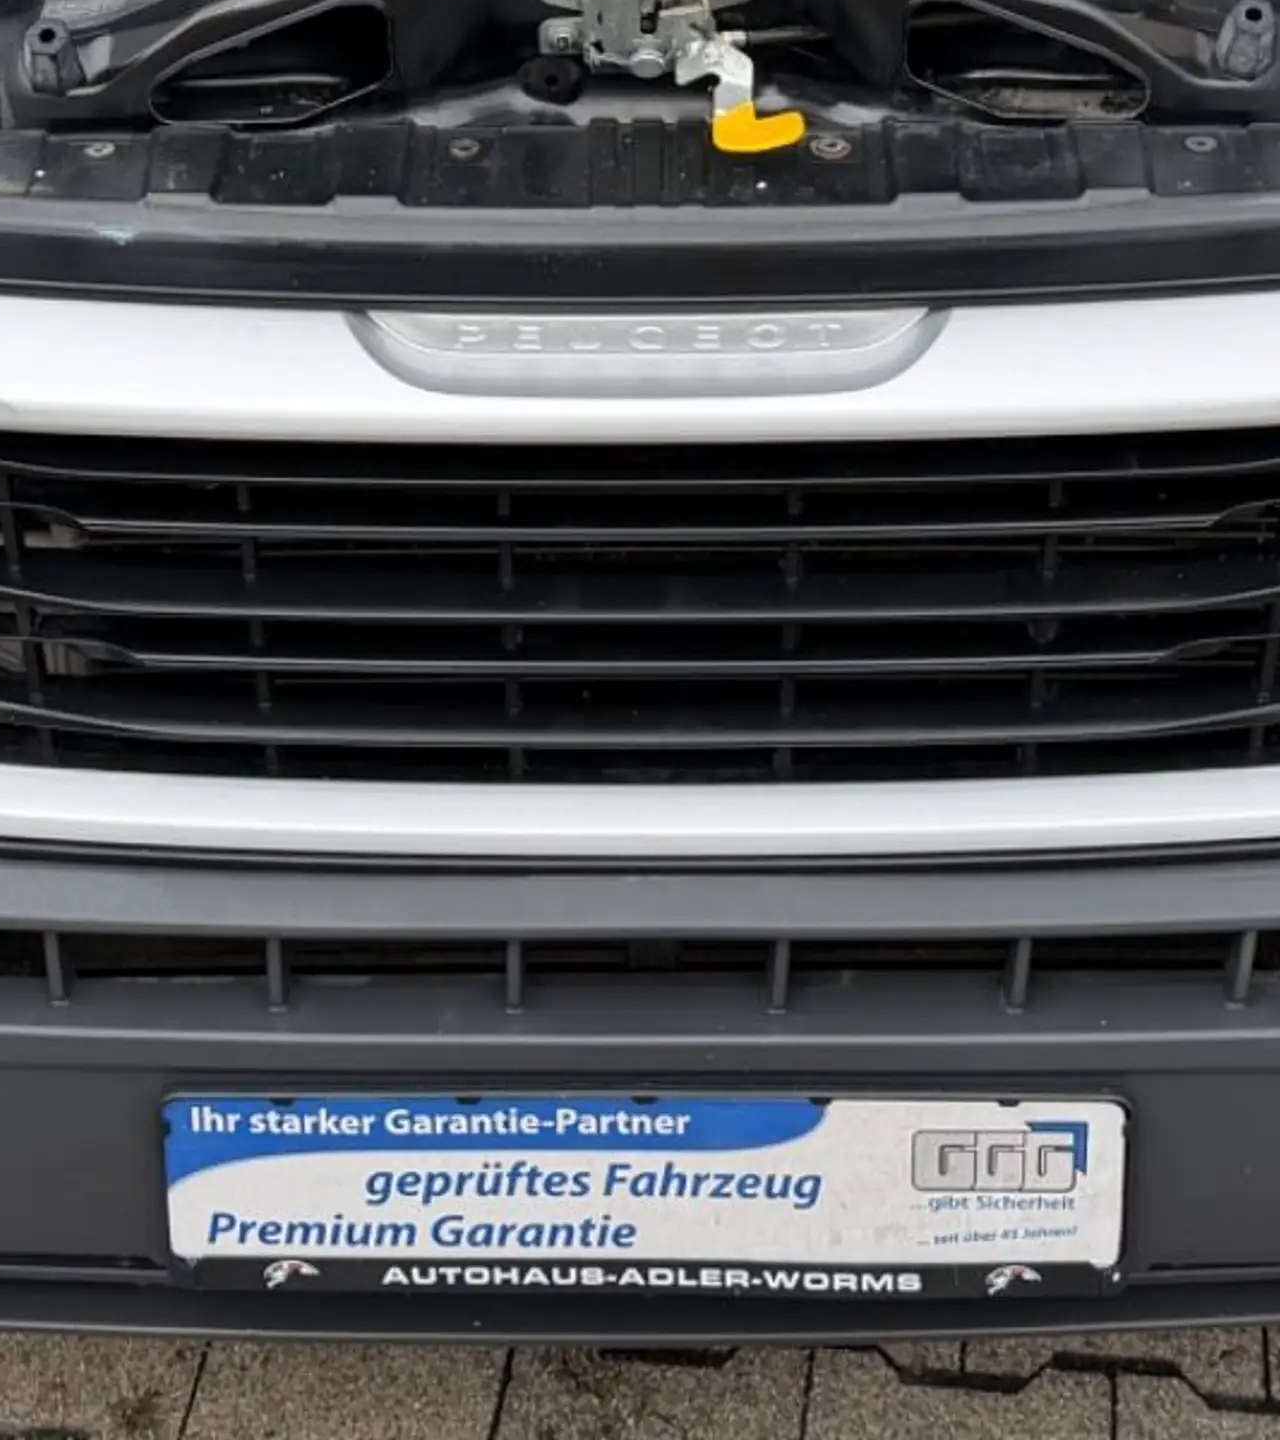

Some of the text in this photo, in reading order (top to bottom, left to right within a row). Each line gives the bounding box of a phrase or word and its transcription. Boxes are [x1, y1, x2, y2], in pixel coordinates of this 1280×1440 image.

[453, 323, 842, 350] PEUGEOT
[190, 1107, 691, 1136] Ihr starker Garantie-Partner
[365, 1160, 821, 1209] geprüftes Fahrzeug
[975, 1195, 1076, 1211] Sicherheit
[207, 1212, 637, 1248] Premium Garantie
[381, 1264, 923, 1293] AUTOHAUS-ADLER-WORMS
